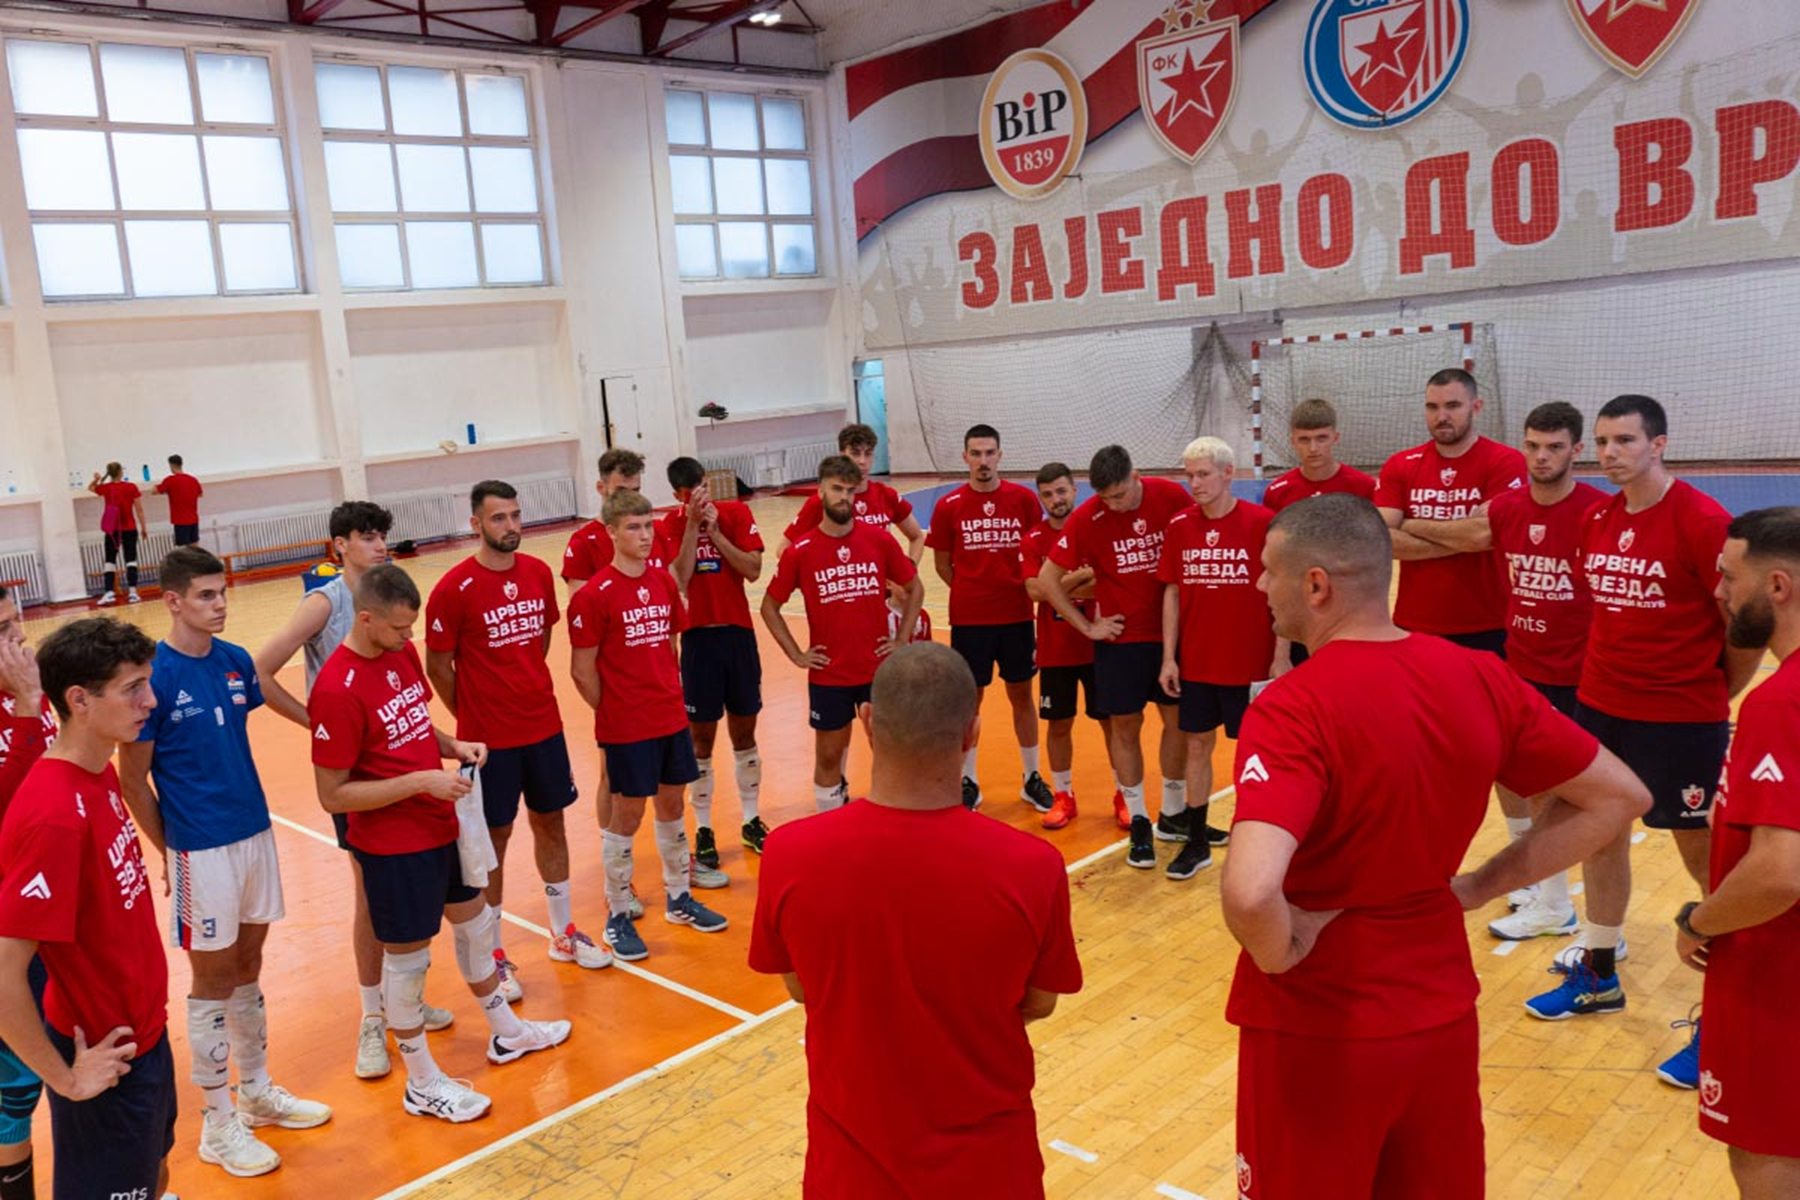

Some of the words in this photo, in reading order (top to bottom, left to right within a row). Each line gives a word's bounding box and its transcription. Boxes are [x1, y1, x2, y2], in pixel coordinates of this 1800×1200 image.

[1151, 53, 1178, 72] ФК
[994, 89, 1067, 143] BiP
[1013, 147, 1055, 173] 1839
[958, 172, 1353, 309] ЗАЈЕДНО
[1400, 138, 1560, 275] ДО
[961, 517, 1022, 531] ЦРВЕНА
[962, 530, 1022, 543] ЗВЕЗДА
[1182, 548, 1249, 563] ЦРВЕНА
[814, 562, 879, 583] ЦРВЕНА
[1183, 563, 1249, 578] ЗВЕЗДА
[818, 575, 880, 597] ЗВЕЗДА
[1512, 615, 1547, 633] mts
